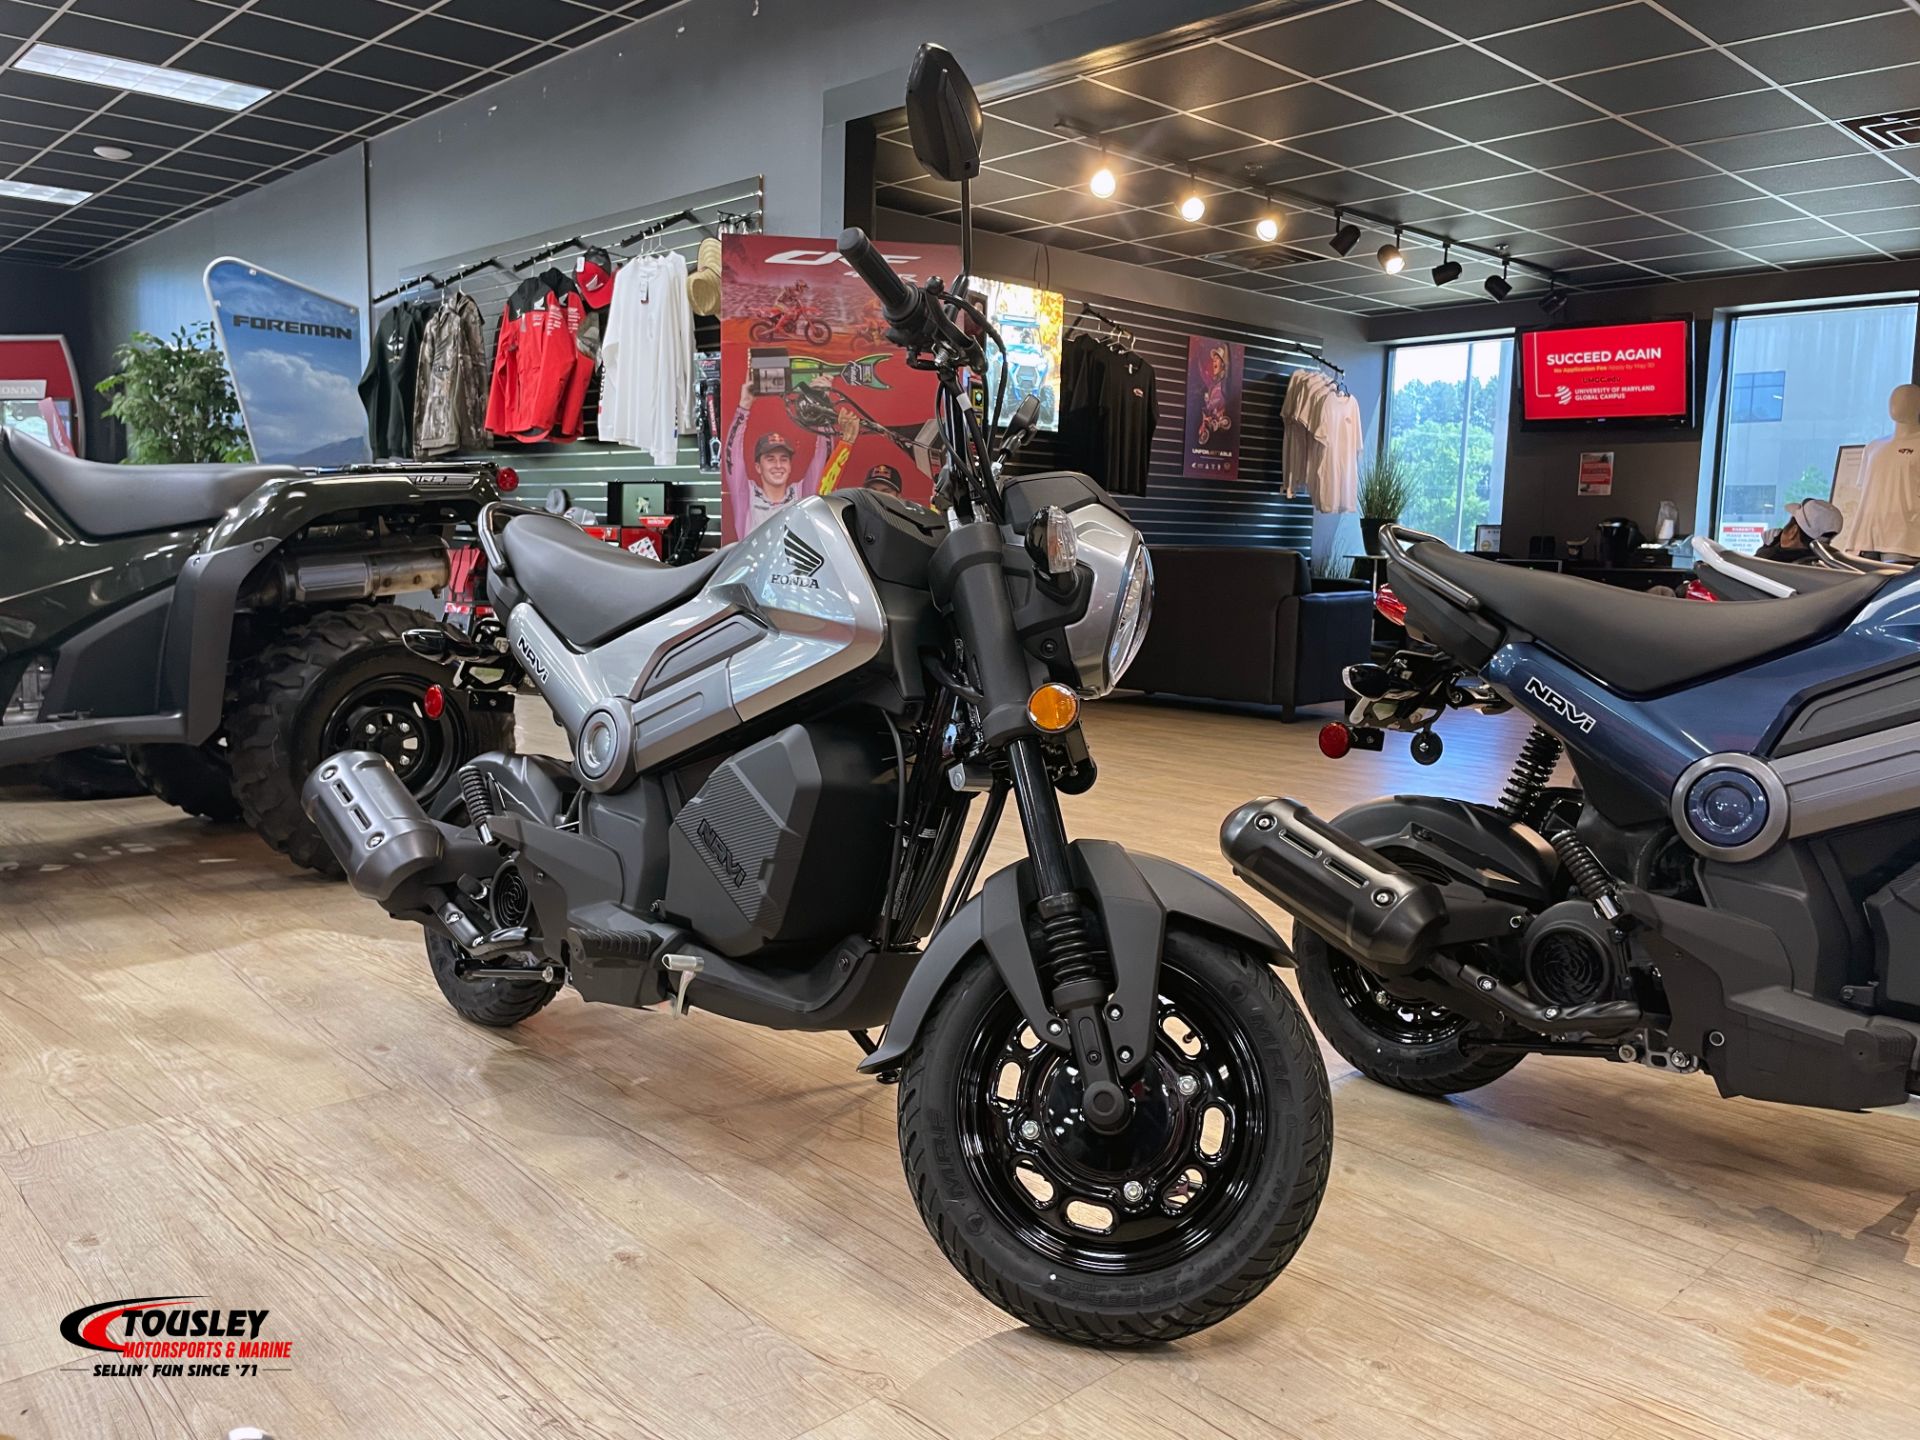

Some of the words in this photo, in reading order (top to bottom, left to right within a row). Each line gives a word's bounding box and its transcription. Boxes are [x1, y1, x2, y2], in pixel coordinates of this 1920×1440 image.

[233, 314, 353, 341] FOREMAN
[1546, 350, 1612, 366] SUCCEED
[1614, 346, 1662, 362] AGAIN
[0, 386, 39, 395] ONDA
[1574, 386, 1611, 395] UNIVERSITY
[1611, 386, 1620, 394] OF
[1621, 384, 1656, 393] MARYLAND
[1574, 394, 1599, 402] GLOBAL
[1599, 393, 1626, 401] CAMPUS
[771, 574, 820, 589] HONDA
